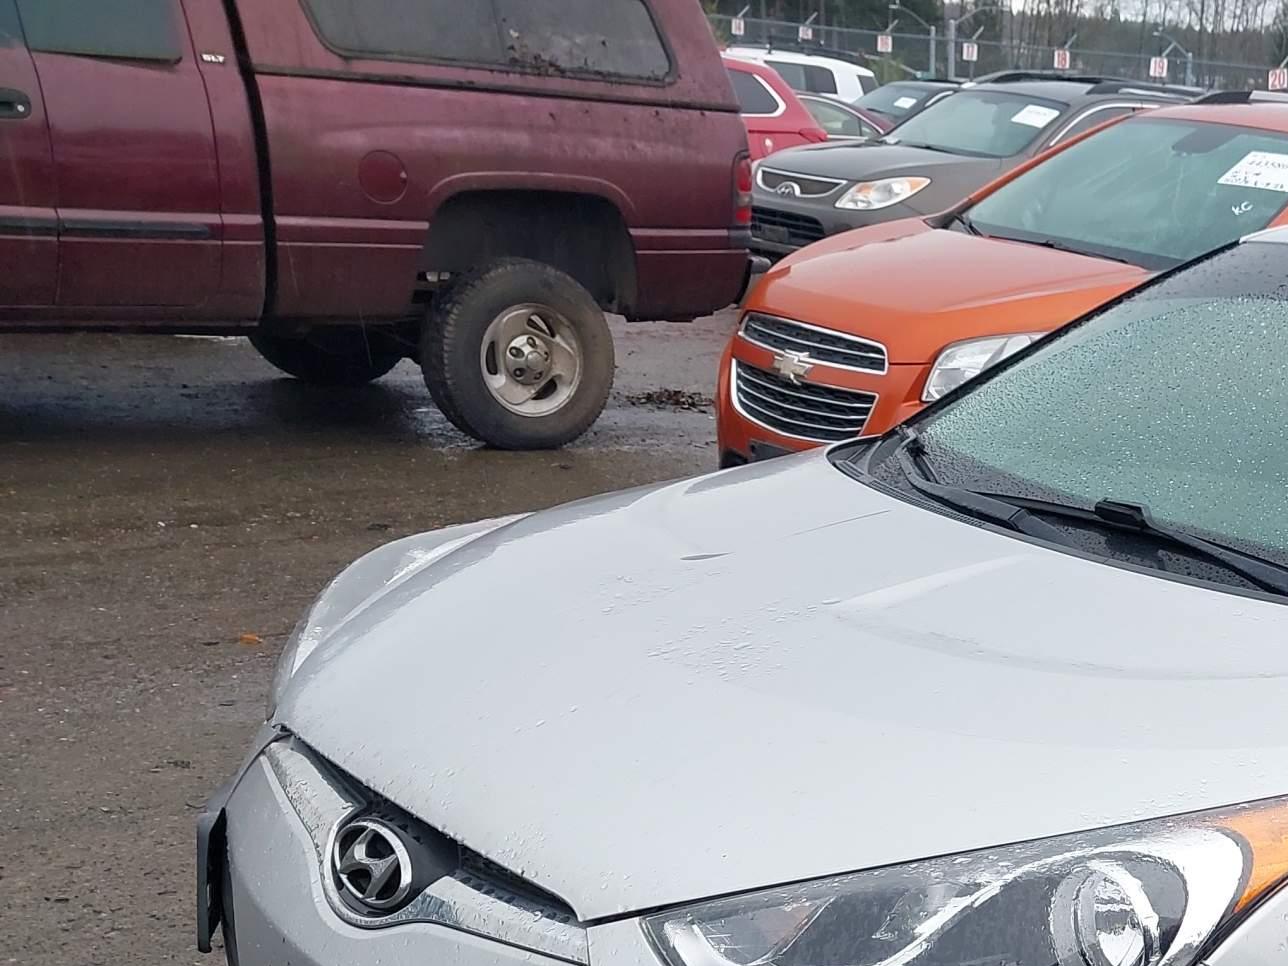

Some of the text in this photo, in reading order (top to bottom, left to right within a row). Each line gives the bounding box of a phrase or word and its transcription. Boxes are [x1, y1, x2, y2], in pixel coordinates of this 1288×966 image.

[966, 45, 975, 59] 17
[1057, 51, 1067, 67] 18
[1152, 58, 1164, 76] 19
[1270, 69, 1286, 89] 20
